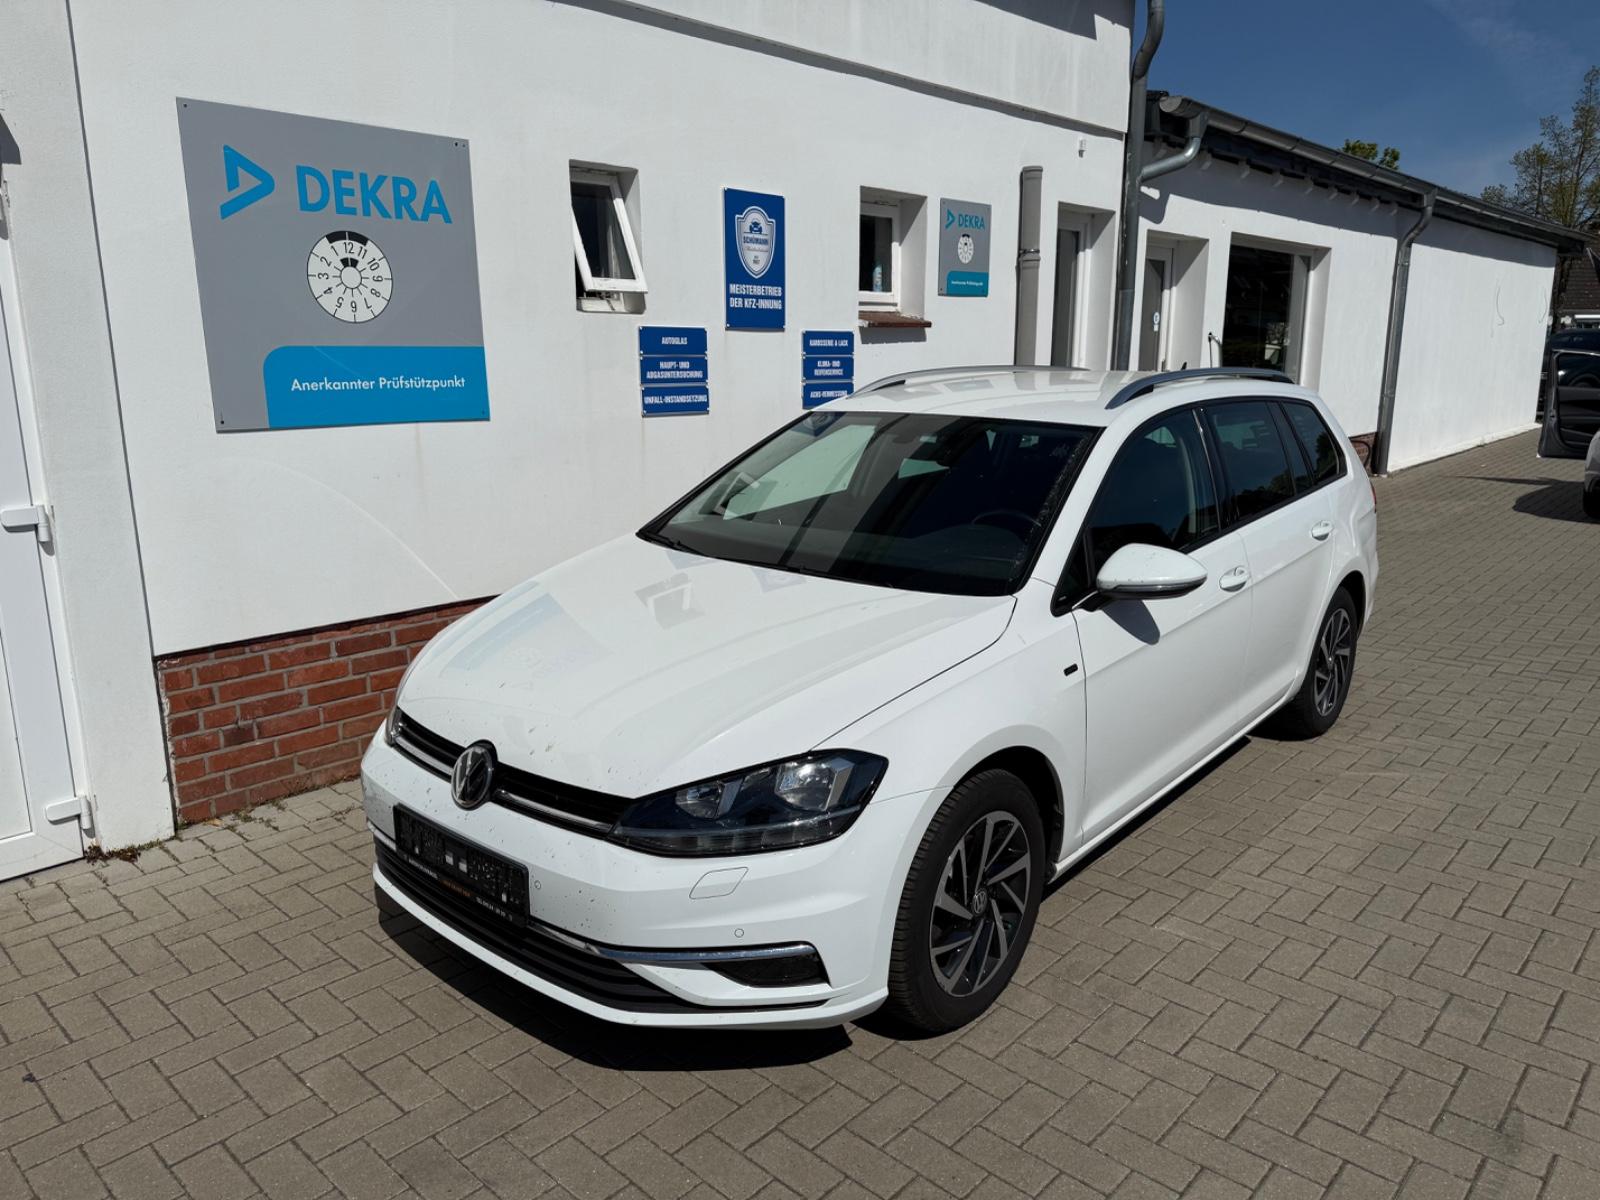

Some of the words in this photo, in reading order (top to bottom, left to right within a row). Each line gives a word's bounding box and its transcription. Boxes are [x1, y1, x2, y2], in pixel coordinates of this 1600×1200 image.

[295, 165, 453, 224] DEKRA
[958, 213, 985, 230] DEKRA
[330, 245, 339, 256] 1
[343, 241, 355, 254] 12
[357, 246, 368, 259] 11
[320, 256, 332, 267] 2
[367, 257, 380, 271] 10
[317, 272, 329, 280] 3
[323, 286, 333, 295] 4
[370, 288, 381, 298] 8
[729, 284, 783, 297] MEISTERBETRIEB
[335, 296, 344, 308] 5
[350, 300, 357, 313] 6
[364, 297, 372, 309] 7
[729, 297, 744, 308] DER
[744, 298, 782, 310] KFZ-INNUNG
[661, 336, 688, 345] AUTOGLAS
[679, 361, 690, 369] UND
[290, 377, 375, 392] Anerkannter
[378, 375, 466, 392] Prüfstützpunkt
